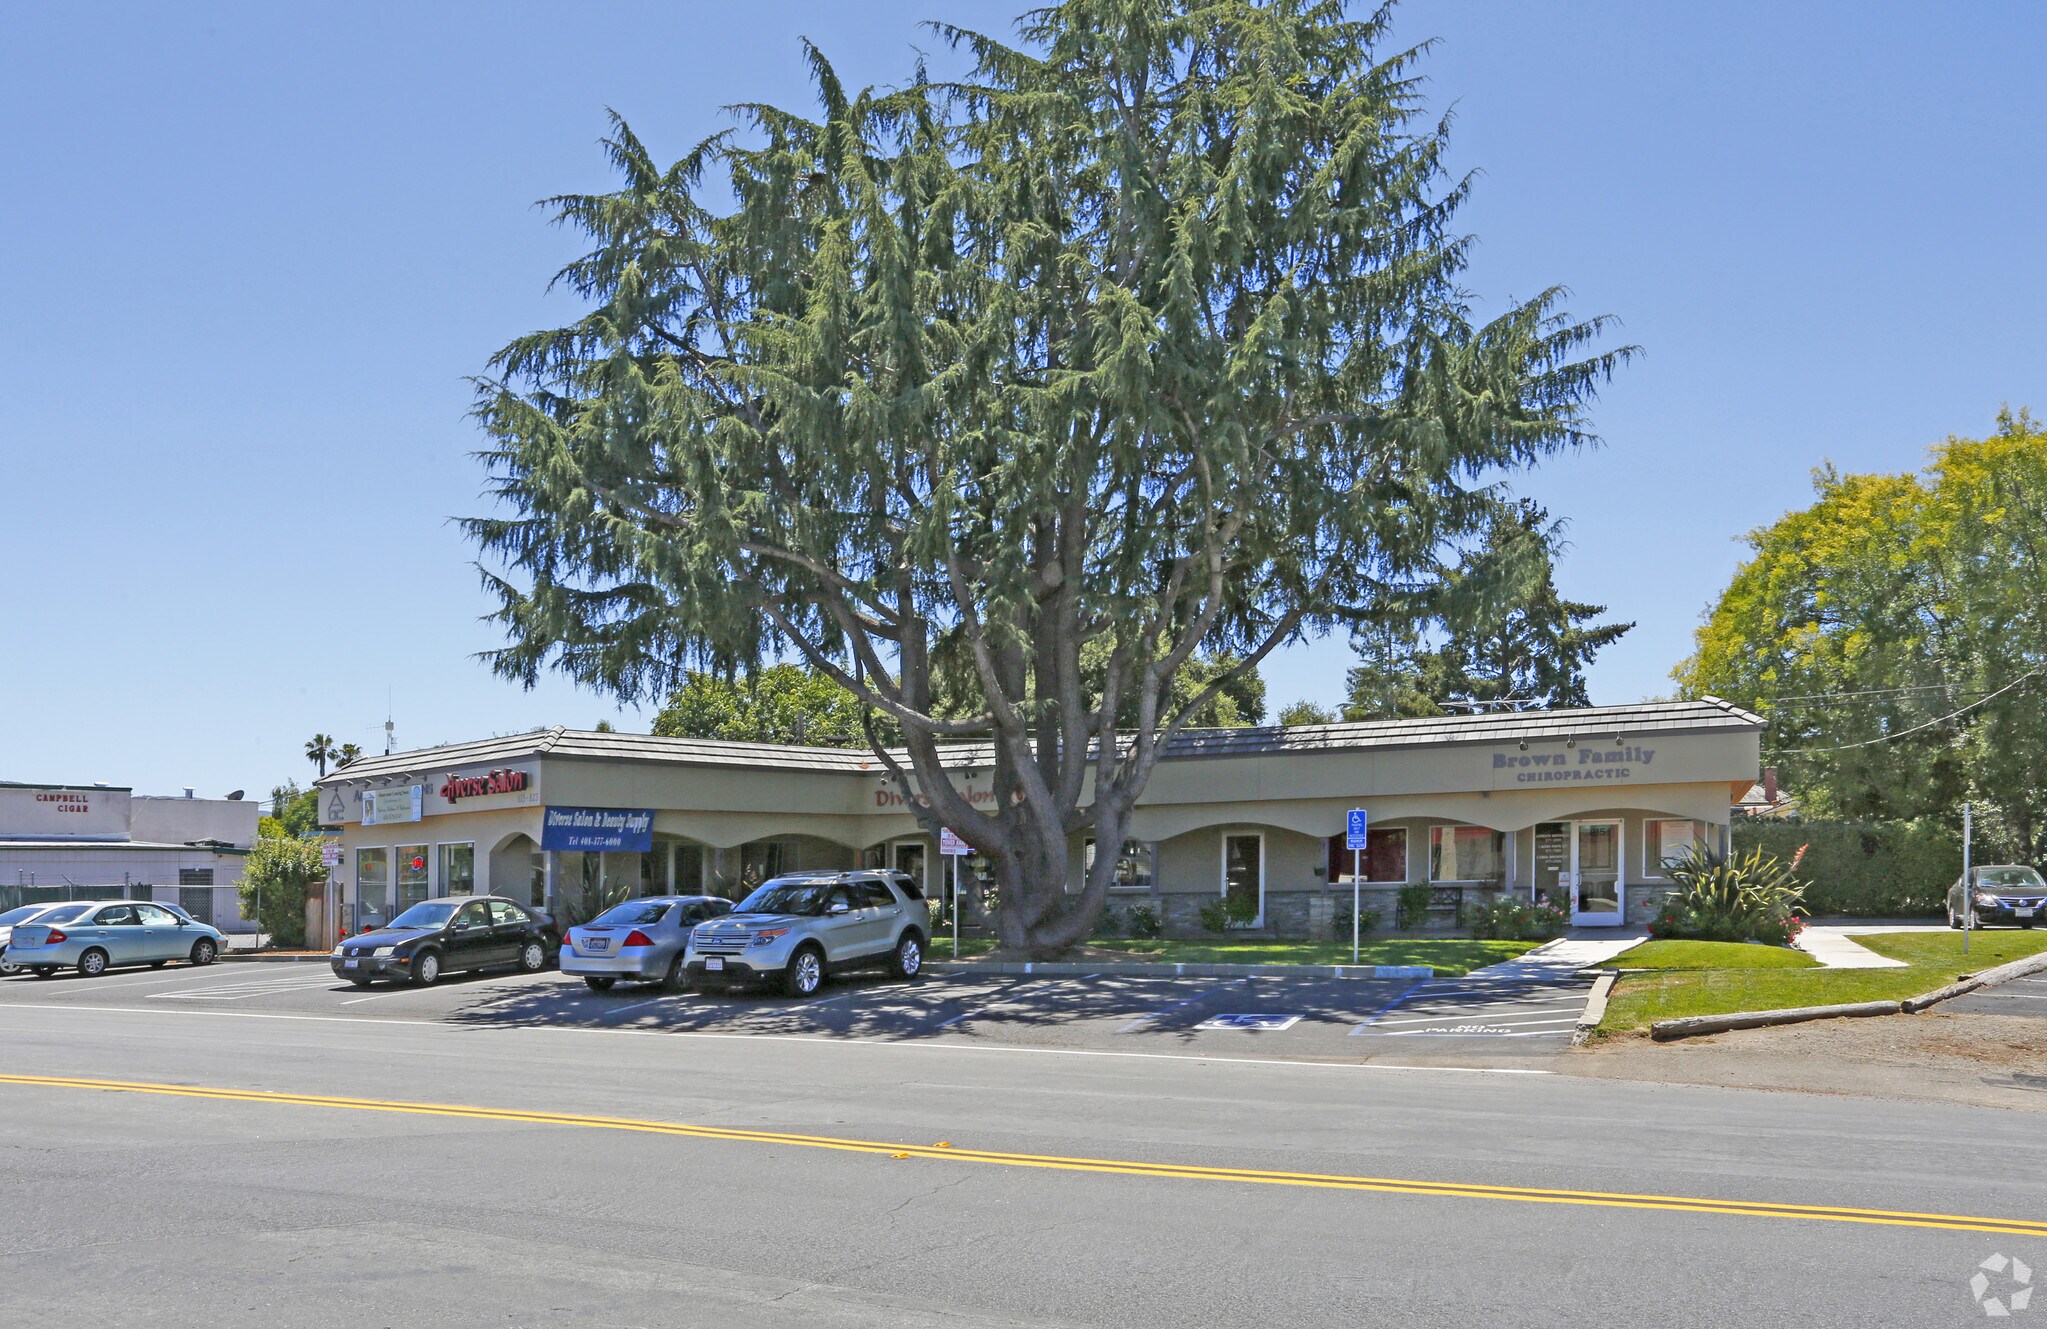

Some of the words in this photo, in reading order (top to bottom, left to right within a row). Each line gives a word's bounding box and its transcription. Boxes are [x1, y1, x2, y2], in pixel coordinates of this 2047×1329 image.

[1492, 752, 1567, 769] Brown
[1578, 746, 1656, 765] Family
[487, 768, 525, 794] Salon
[1517, 768, 1630, 782] CHIROPRACTIC
[36, 794, 88, 803] CAMPBELL
[548, 811, 572, 826] Diverse
[573, 810, 594, 827] Salon
[594, 812, 601, 827] &
[602, 812, 626, 833] Beauty
[626, 812, 649, 834] Supply
[568, 837, 578, 845] Tel
